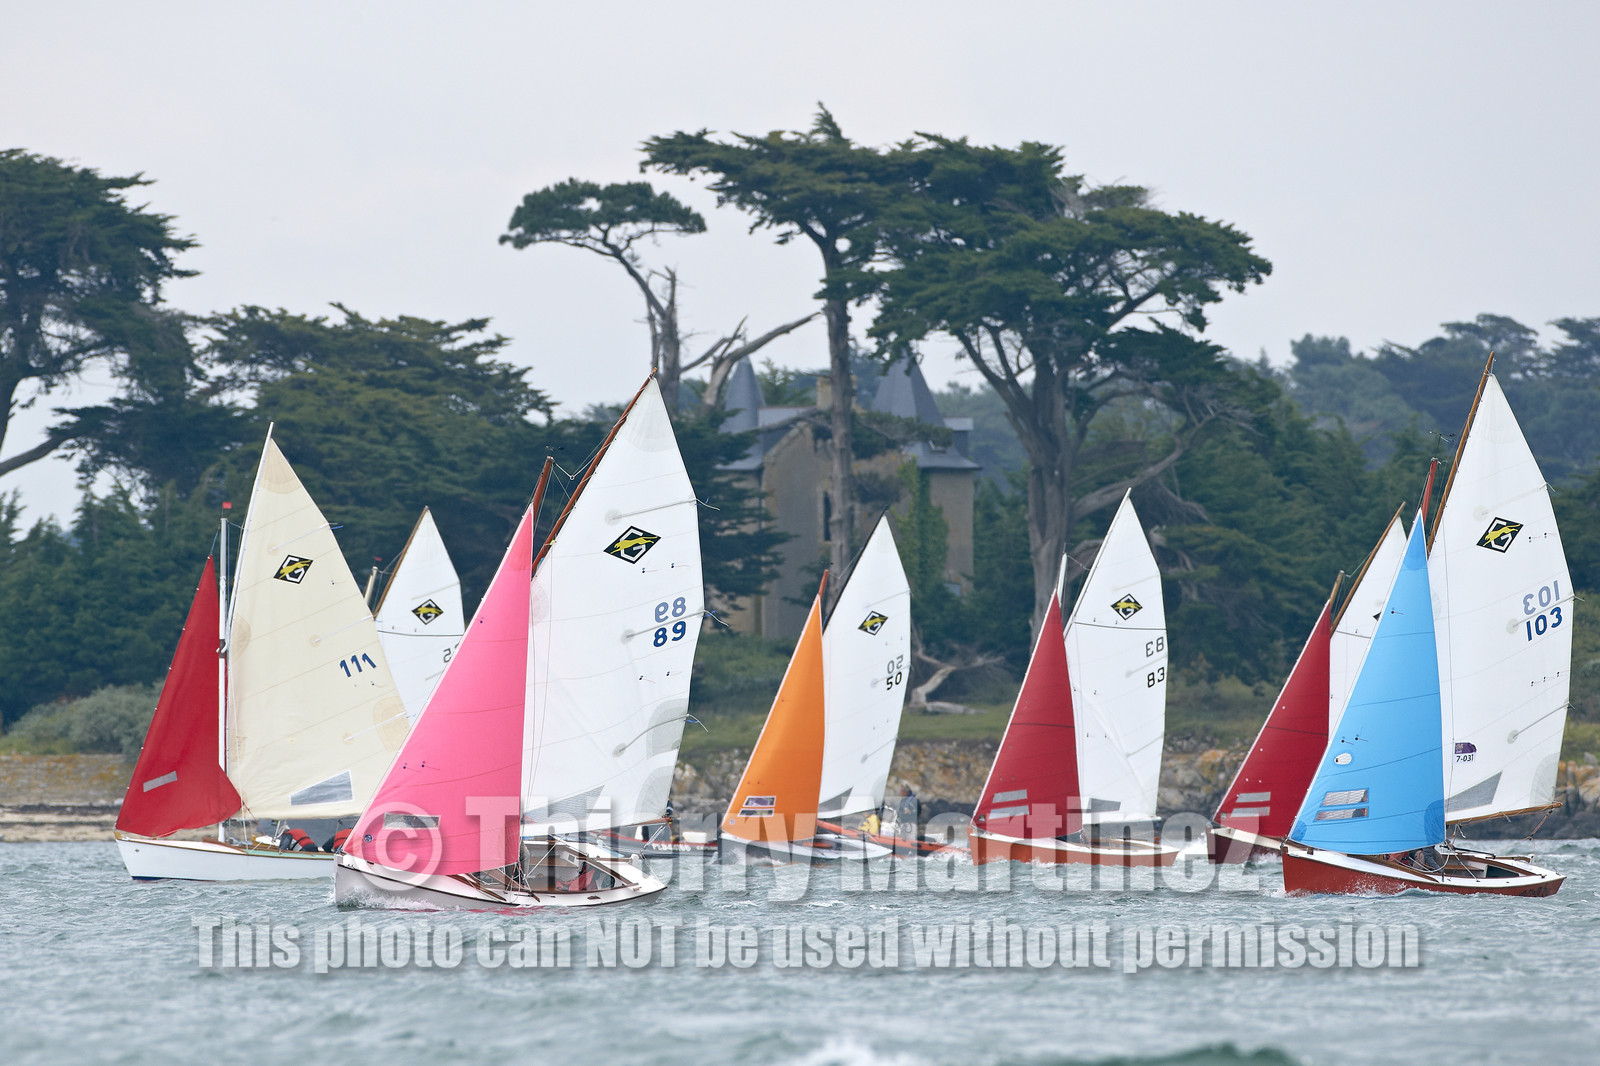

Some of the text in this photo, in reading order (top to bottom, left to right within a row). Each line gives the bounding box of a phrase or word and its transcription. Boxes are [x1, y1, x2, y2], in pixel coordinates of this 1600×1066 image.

[653, 620, 686, 647] 89
[1526, 606, 1562, 641] 103
[339, 652, 376, 677] 111
[886, 671, 902, 691] 50
[1147, 666, 1165, 688] 83
[1456, 754, 1474, 762] 7-031
